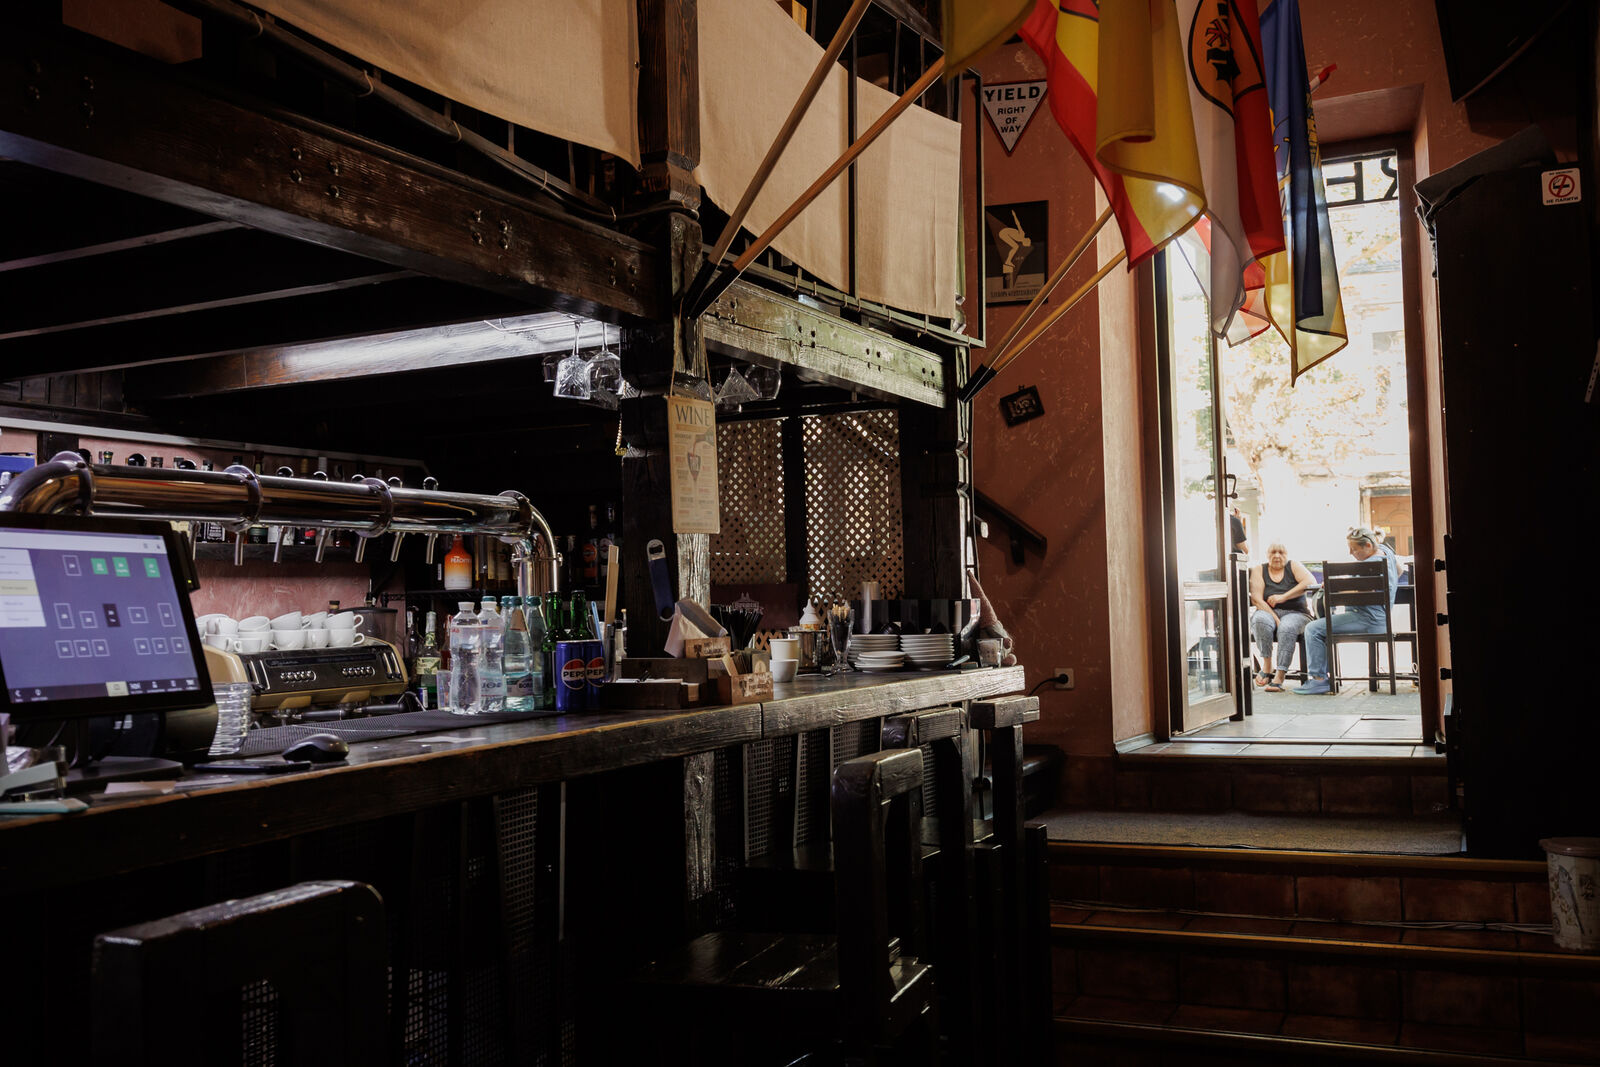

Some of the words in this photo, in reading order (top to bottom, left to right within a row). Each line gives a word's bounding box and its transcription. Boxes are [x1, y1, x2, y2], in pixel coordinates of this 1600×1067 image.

[984, 86, 1040, 102] YIELD
[997, 106, 1026, 115] RIGHT
[1000, 125, 1021, 133] WAY
[675, 404, 710, 427] WINE
[563, 670, 585, 678] PEPS
